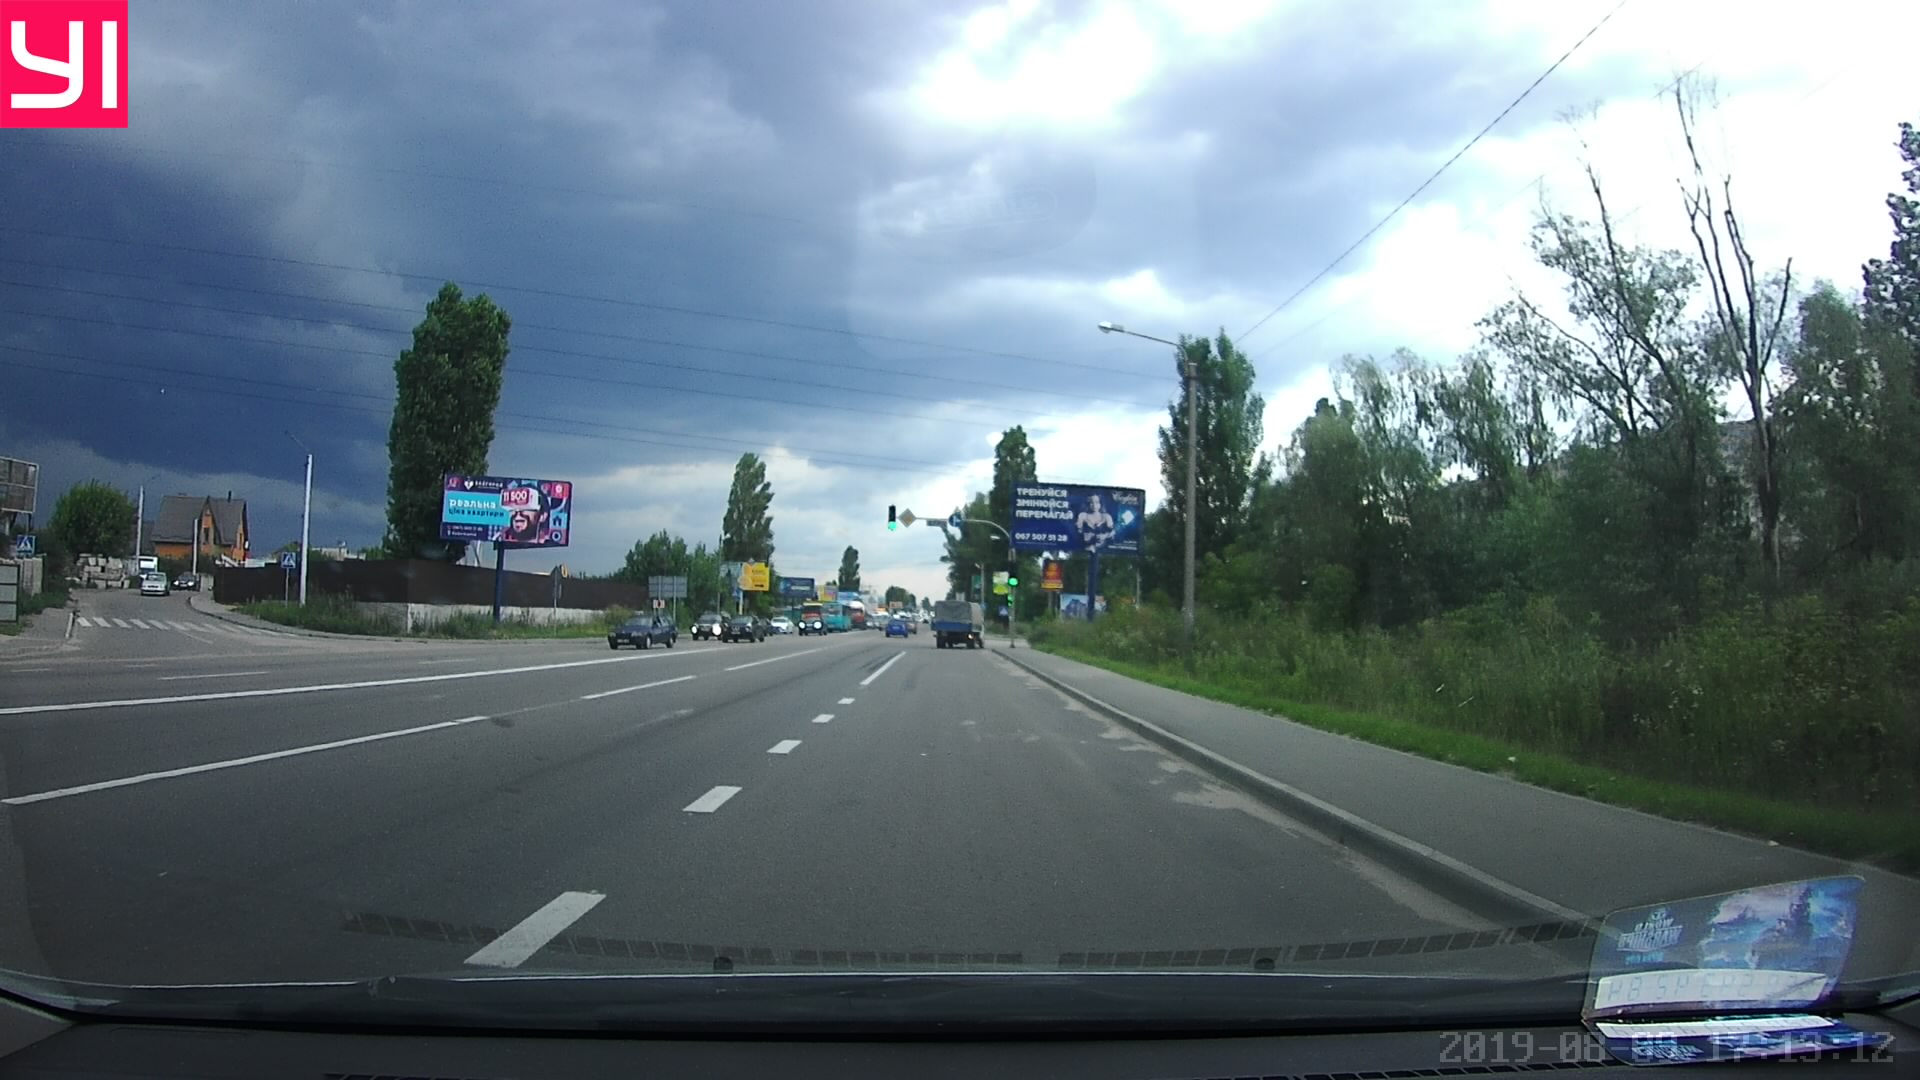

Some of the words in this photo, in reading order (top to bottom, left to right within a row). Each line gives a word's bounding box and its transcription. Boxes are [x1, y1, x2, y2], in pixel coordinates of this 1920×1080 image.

[510, 490, 528, 502] 500
[1016, 487, 1067, 497] ТРЕНУЙСЯ
[449, 498, 496, 509] реальна
[1016, 498, 1069, 508] ЗМІНЮЙСЯ
[1015, 510, 1073, 519] ПЕРЕМАГАЙ
